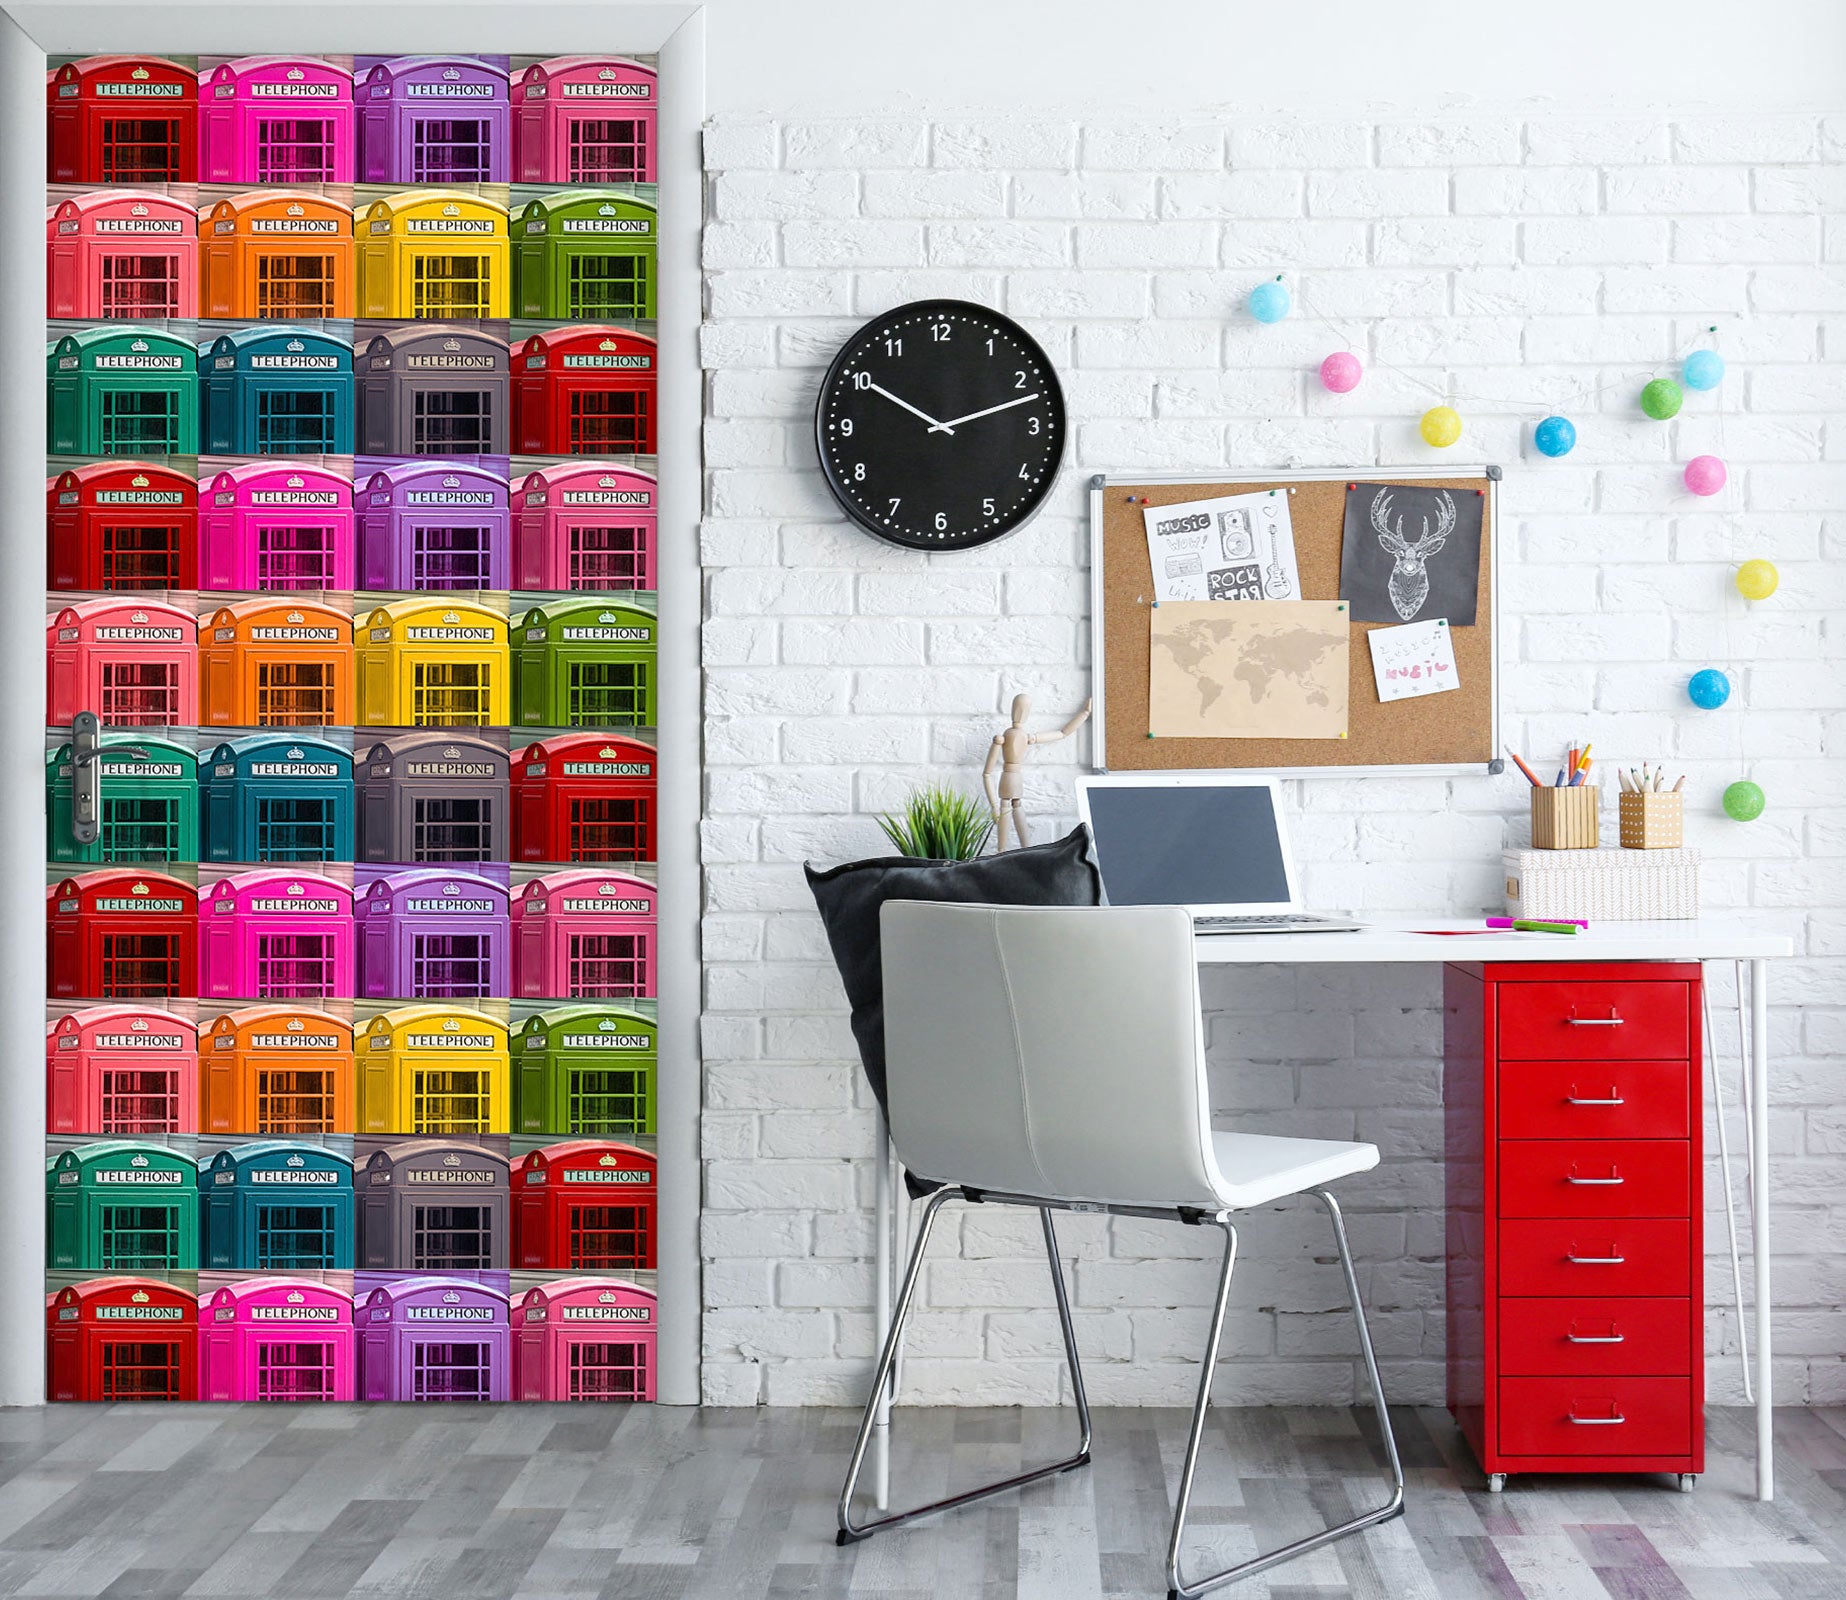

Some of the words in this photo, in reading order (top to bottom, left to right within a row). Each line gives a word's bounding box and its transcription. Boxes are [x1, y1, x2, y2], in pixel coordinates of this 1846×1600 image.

[101, 84, 180, 95] TELEPHONE
[256, 84, 335, 95] TELEPHONE
[412, 84, 491, 95] TELEPHONE
[567, 84, 646, 95] TELEPHONE
[100, 220, 179, 231] TELEPHONE
[256, 220, 335, 231] TELEPHONE
[412, 220, 491, 231] TELEPHONE
[567, 220, 646, 231] TELEPHONE
[931, 324, 951, 341] 12
[885, 339, 901, 356] 11
[986, 339, 993, 356] 1
[100, 356, 179, 367] TELEPHONE
[256, 356, 335, 367] TELEPHONE
[412, 355, 491, 366] TELEPHONE
[568, 355, 647, 366] TELEPHONE
[852, 372, 871, 390] 10
[1015, 371, 1026, 388] 2
[841, 419, 852, 436] 9
[1028, 417, 1039, 435] 3
[855, 463, 865, 481] 8
[1019, 463, 1029, 480] 4
[101, 491, 180, 502] TELEPHONE
[256, 492, 335, 503] TELEPHONE
[412, 492, 491, 503] TELEPHONE
[567, 492, 646, 503] TELEPHONE
[889, 499, 900, 516] 7
[983, 499, 994, 516] 5
[935, 512, 947, 530] 6
[1210, 568, 1258, 589] ROCK
[100, 628, 179, 639] TELEPHONE
[256, 628, 335, 639] TELEPHONE
[412, 628, 491, 639] TELEPHONE
[567, 627, 646, 638] TELEPHONE
[256, 763, 335, 774] TELEPHONE
[412, 763, 491, 774] TELEPHONE
[568, 763, 647, 774] TELEPHONE
[101, 899, 180, 910] TELEPHONE
[256, 899, 335, 910] TELEPHONE
[412, 899, 491, 910] TELEPHONE
[567, 899, 646, 910] TELEPHONE
[100, 1035, 179, 1046] TELEPHONE
[256, 1035, 335, 1046] TELEPHONE
[412, 1035, 491, 1046] TELEPHONE
[567, 1035, 646, 1046] TELEPHONE
[100, 1171, 179, 1182] TELEPHONE
[256, 1171, 335, 1182] TELEPHONE
[412, 1170, 491, 1181] TELEPHONE
[568, 1170, 647, 1181] TELEPHONE
[101, 1307, 180, 1318] TELEPHONE
[256, 1307, 335, 1318] TELEPHONE
[412, 1307, 491, 1318] TELEPHONE
[567, 1307, 646, 1318] TELEPHONE
